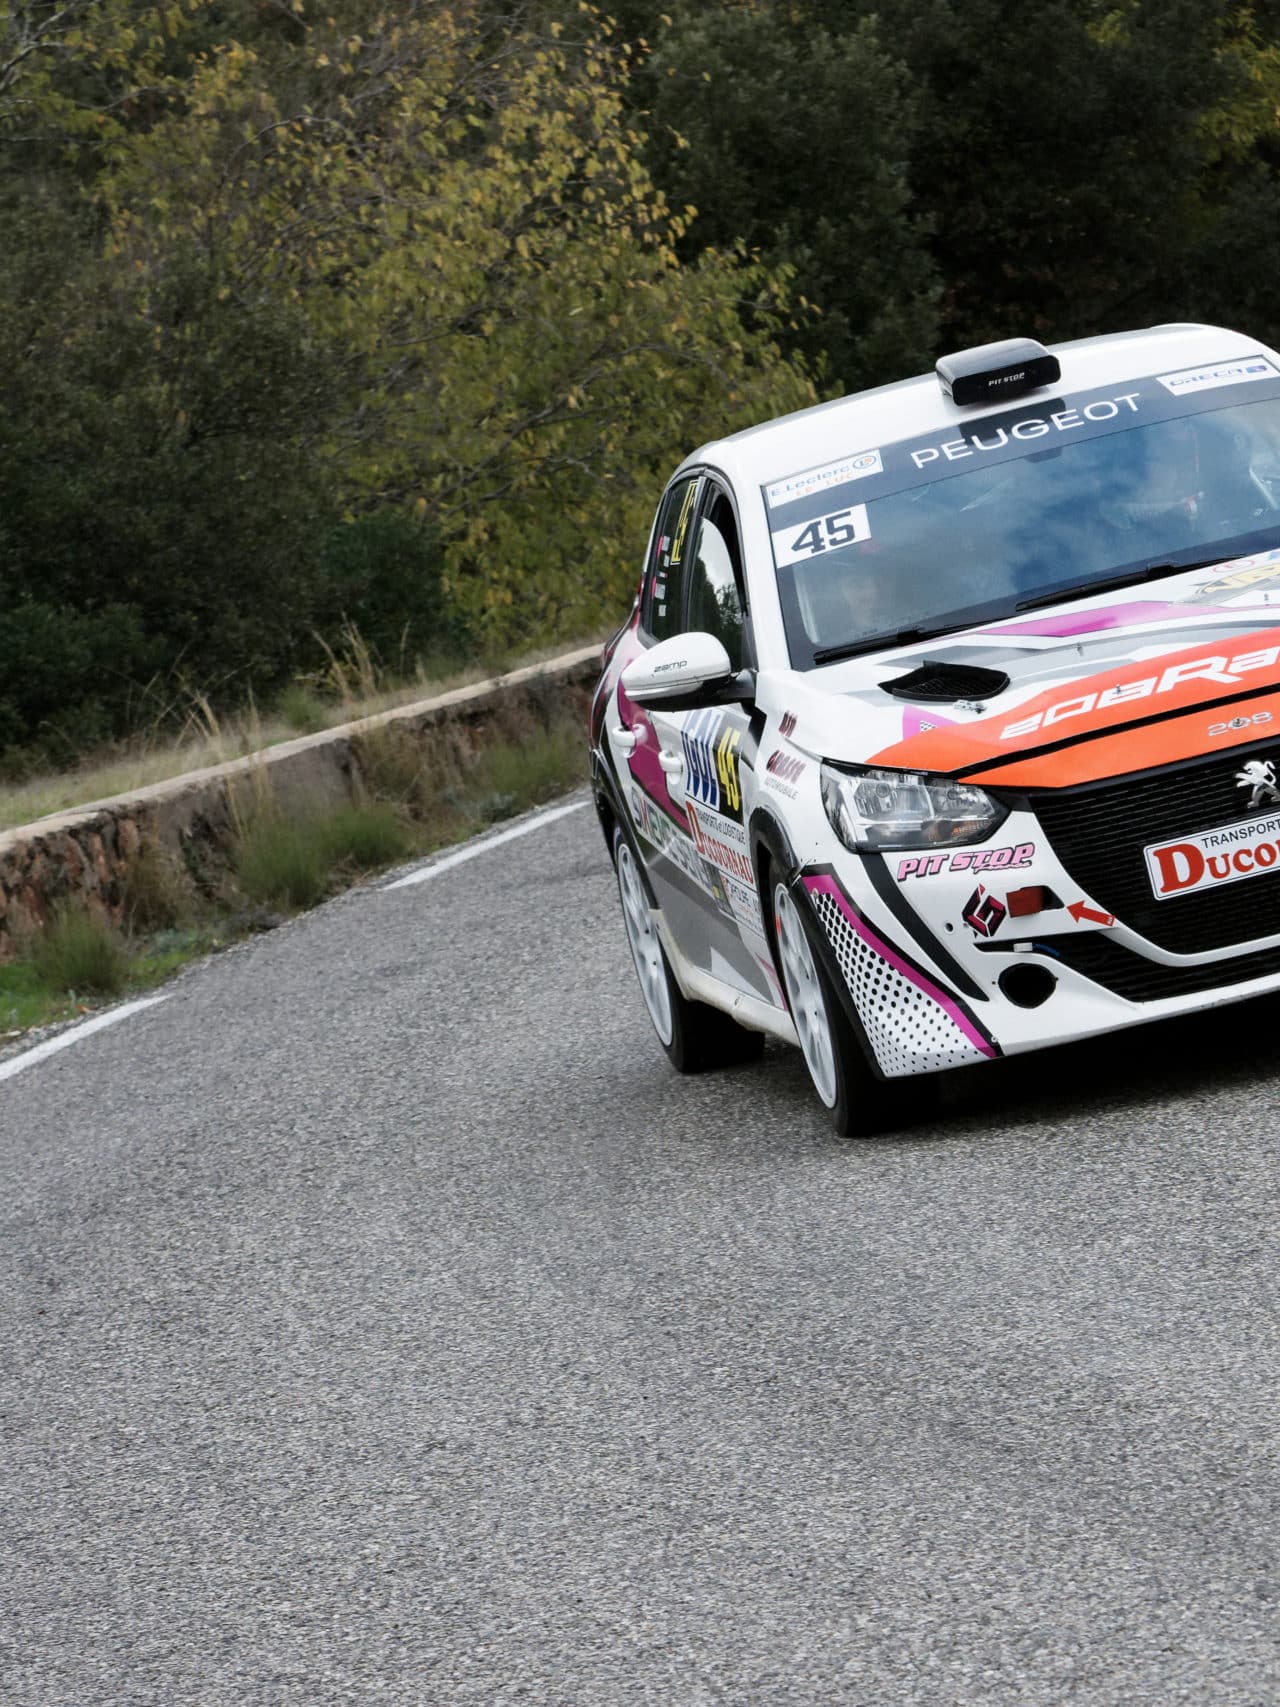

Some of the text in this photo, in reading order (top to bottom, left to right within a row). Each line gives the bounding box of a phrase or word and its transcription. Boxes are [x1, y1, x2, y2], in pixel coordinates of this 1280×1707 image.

[910, 393, 1140, 469] PEUGEOT
[791, 511, 856, 554] 45
[1207, 711, 1273, 737] 208
[897, 854, 950, 882] PIT
[950, 842, 1035, 872] STOP
